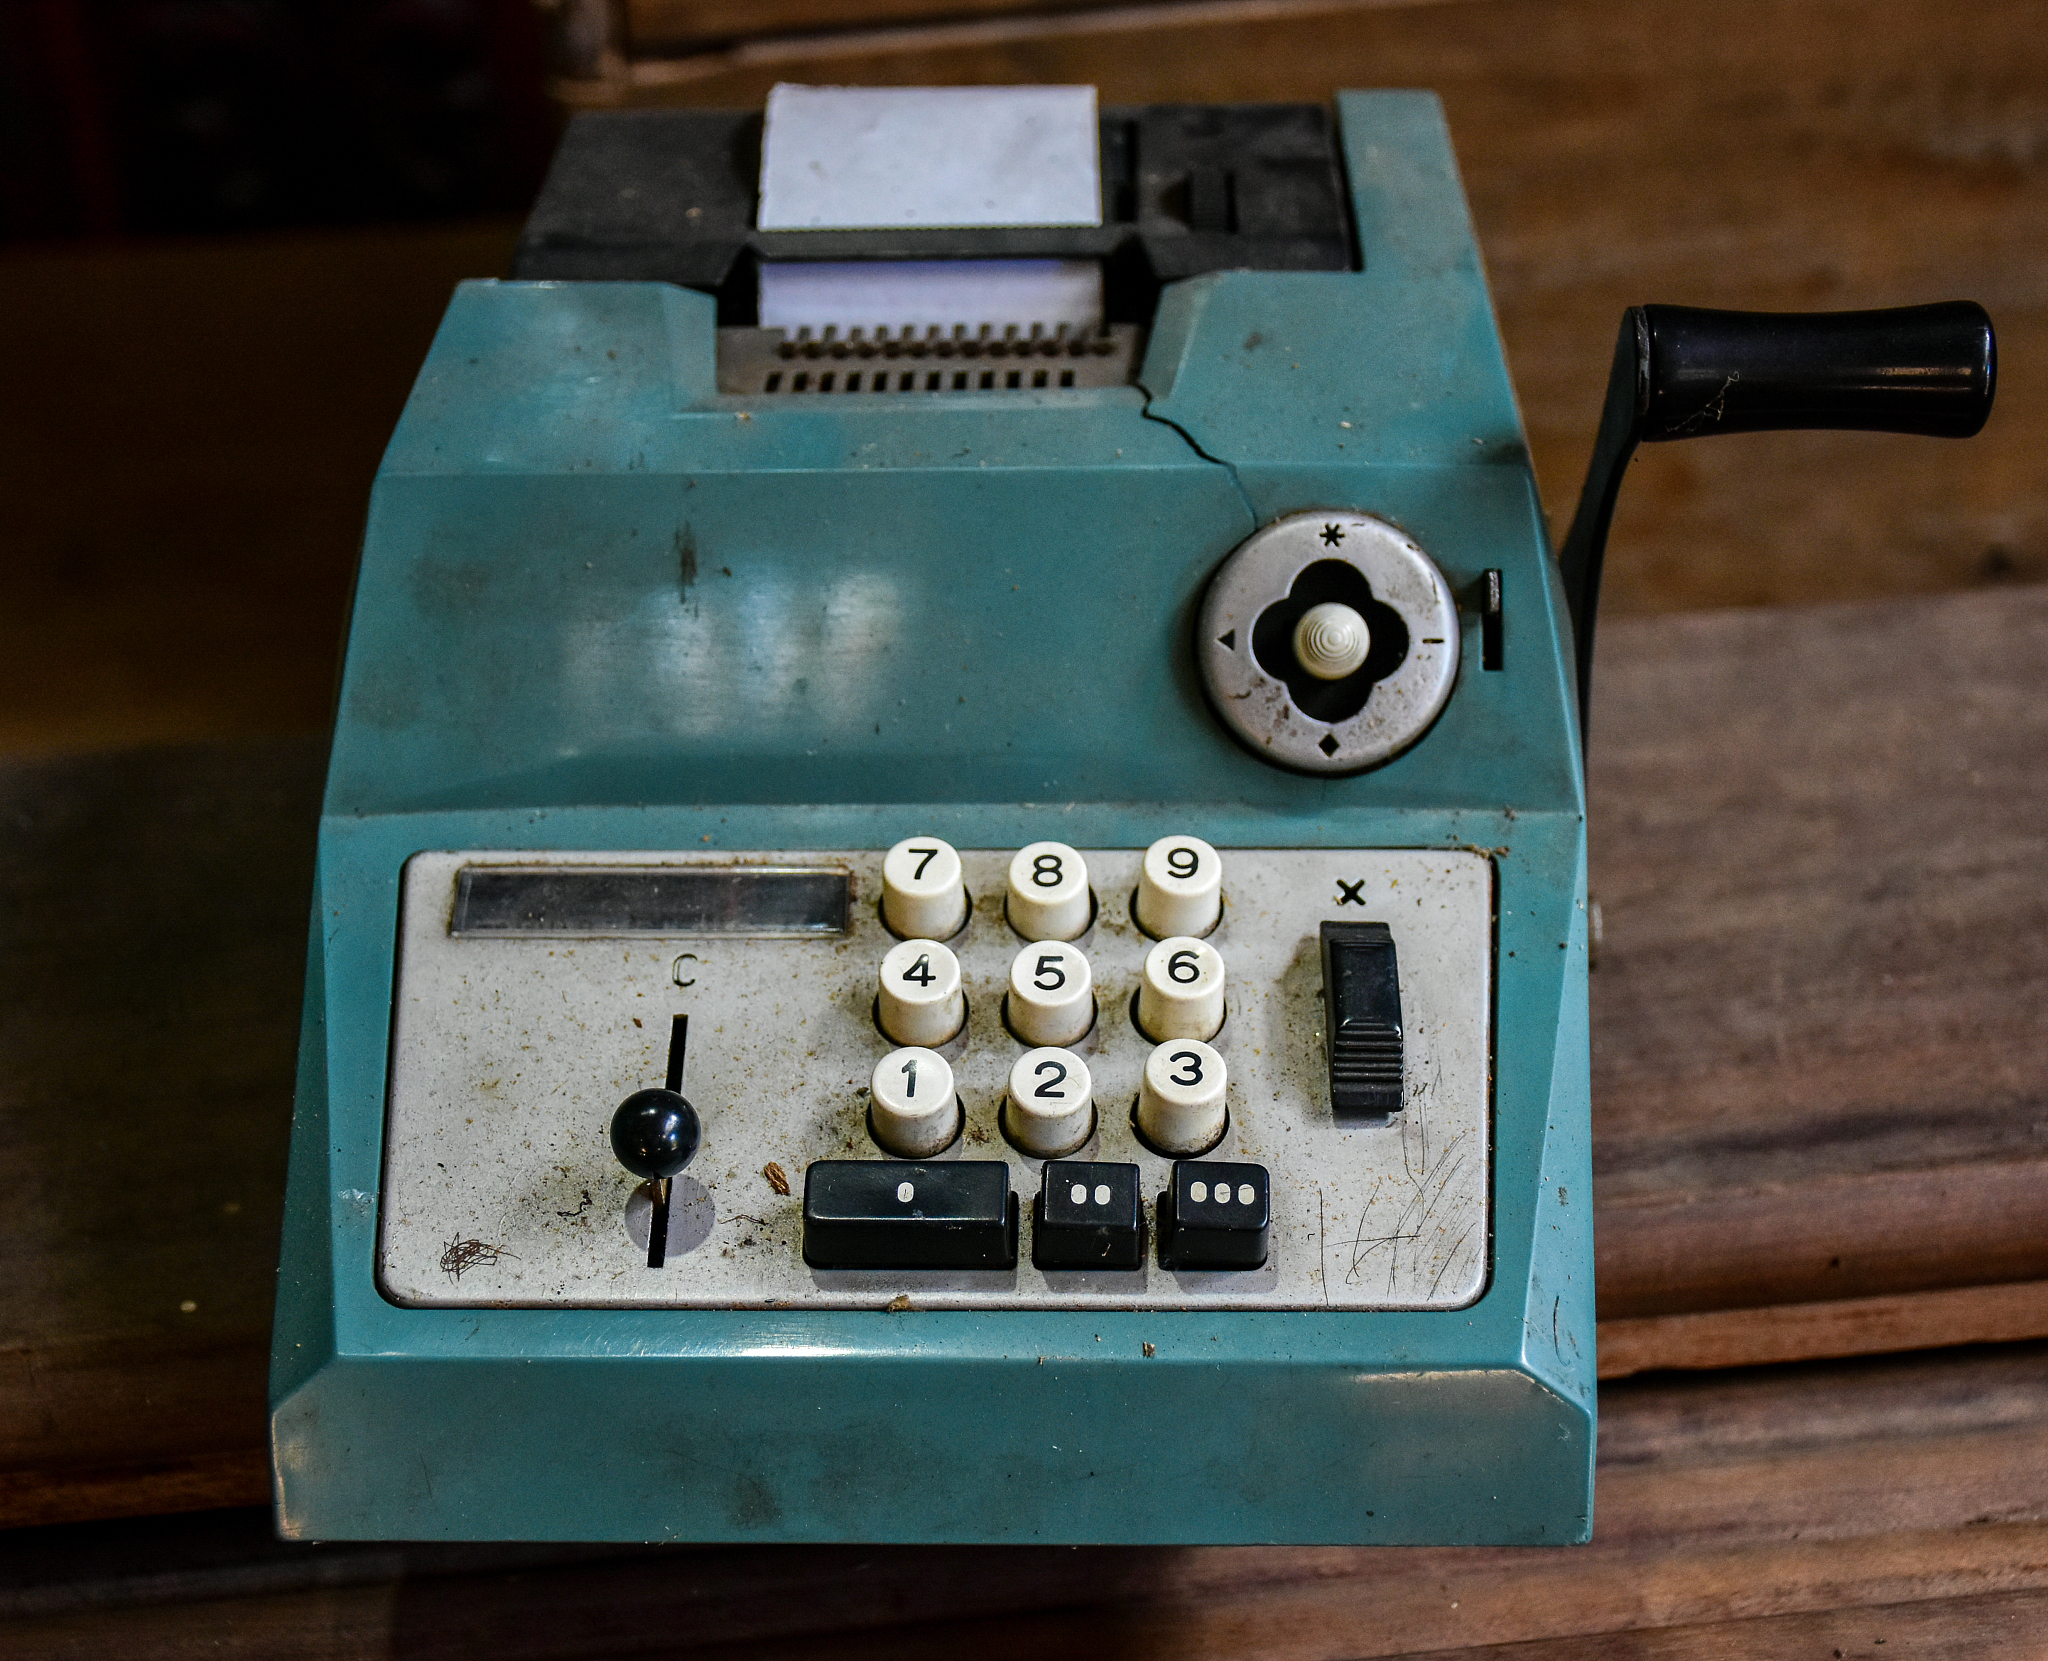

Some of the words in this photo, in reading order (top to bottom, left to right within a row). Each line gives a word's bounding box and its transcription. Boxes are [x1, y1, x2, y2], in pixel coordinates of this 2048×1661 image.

[908, 848, 938, 880] 7
[1032, 854, 1062, 887] 8
[1167, 847, 1199, 879] 9
[672, 952, 698, 987] C
[903, 953, 936, 987] 4
[1034, 956, 1065, 990] 5
[1168, 950, 1200, 983] 6
[901, 1059, 917, 1098] 1
[1034, 1060, 1066, 1098] 2
[1169, 1051, 1203, 1086] 3
